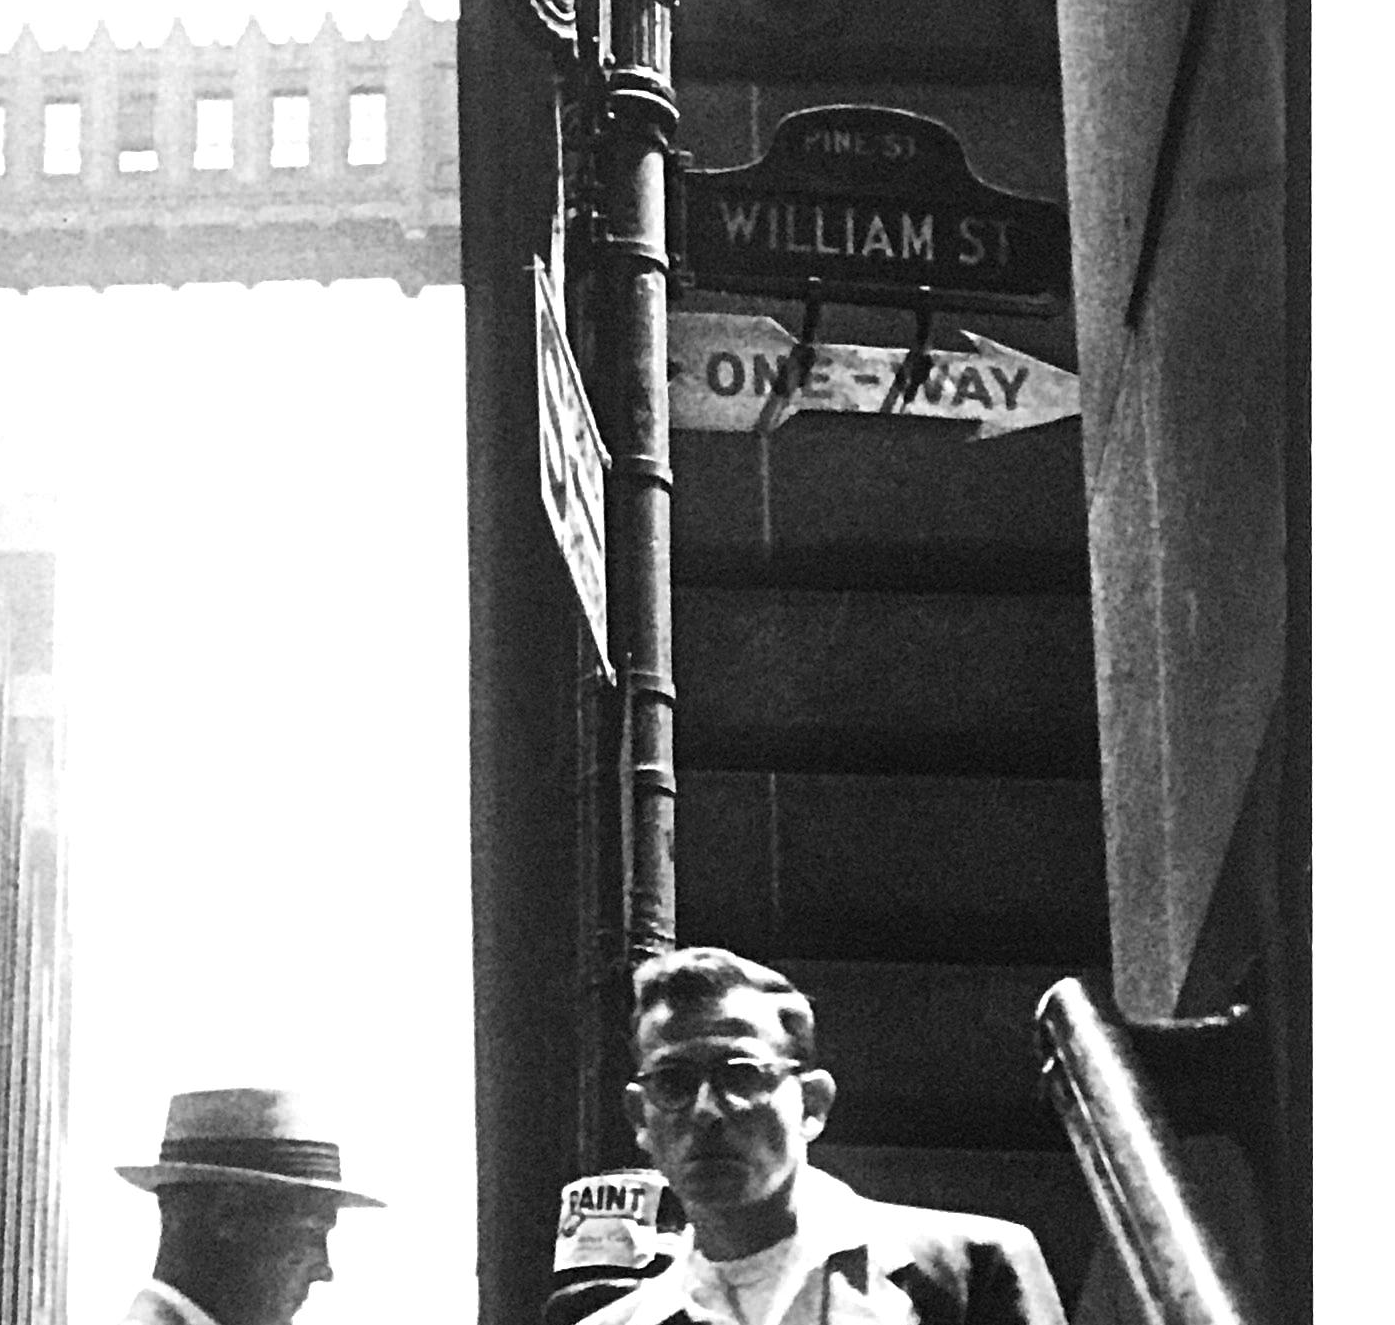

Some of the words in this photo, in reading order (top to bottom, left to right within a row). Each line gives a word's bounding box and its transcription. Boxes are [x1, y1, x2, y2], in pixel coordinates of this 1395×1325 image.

[720, 202, 935, 261] WILLIAM
[959, 217, 1013, 267] ST
[569, 1185, 646, 1213] PAINT
